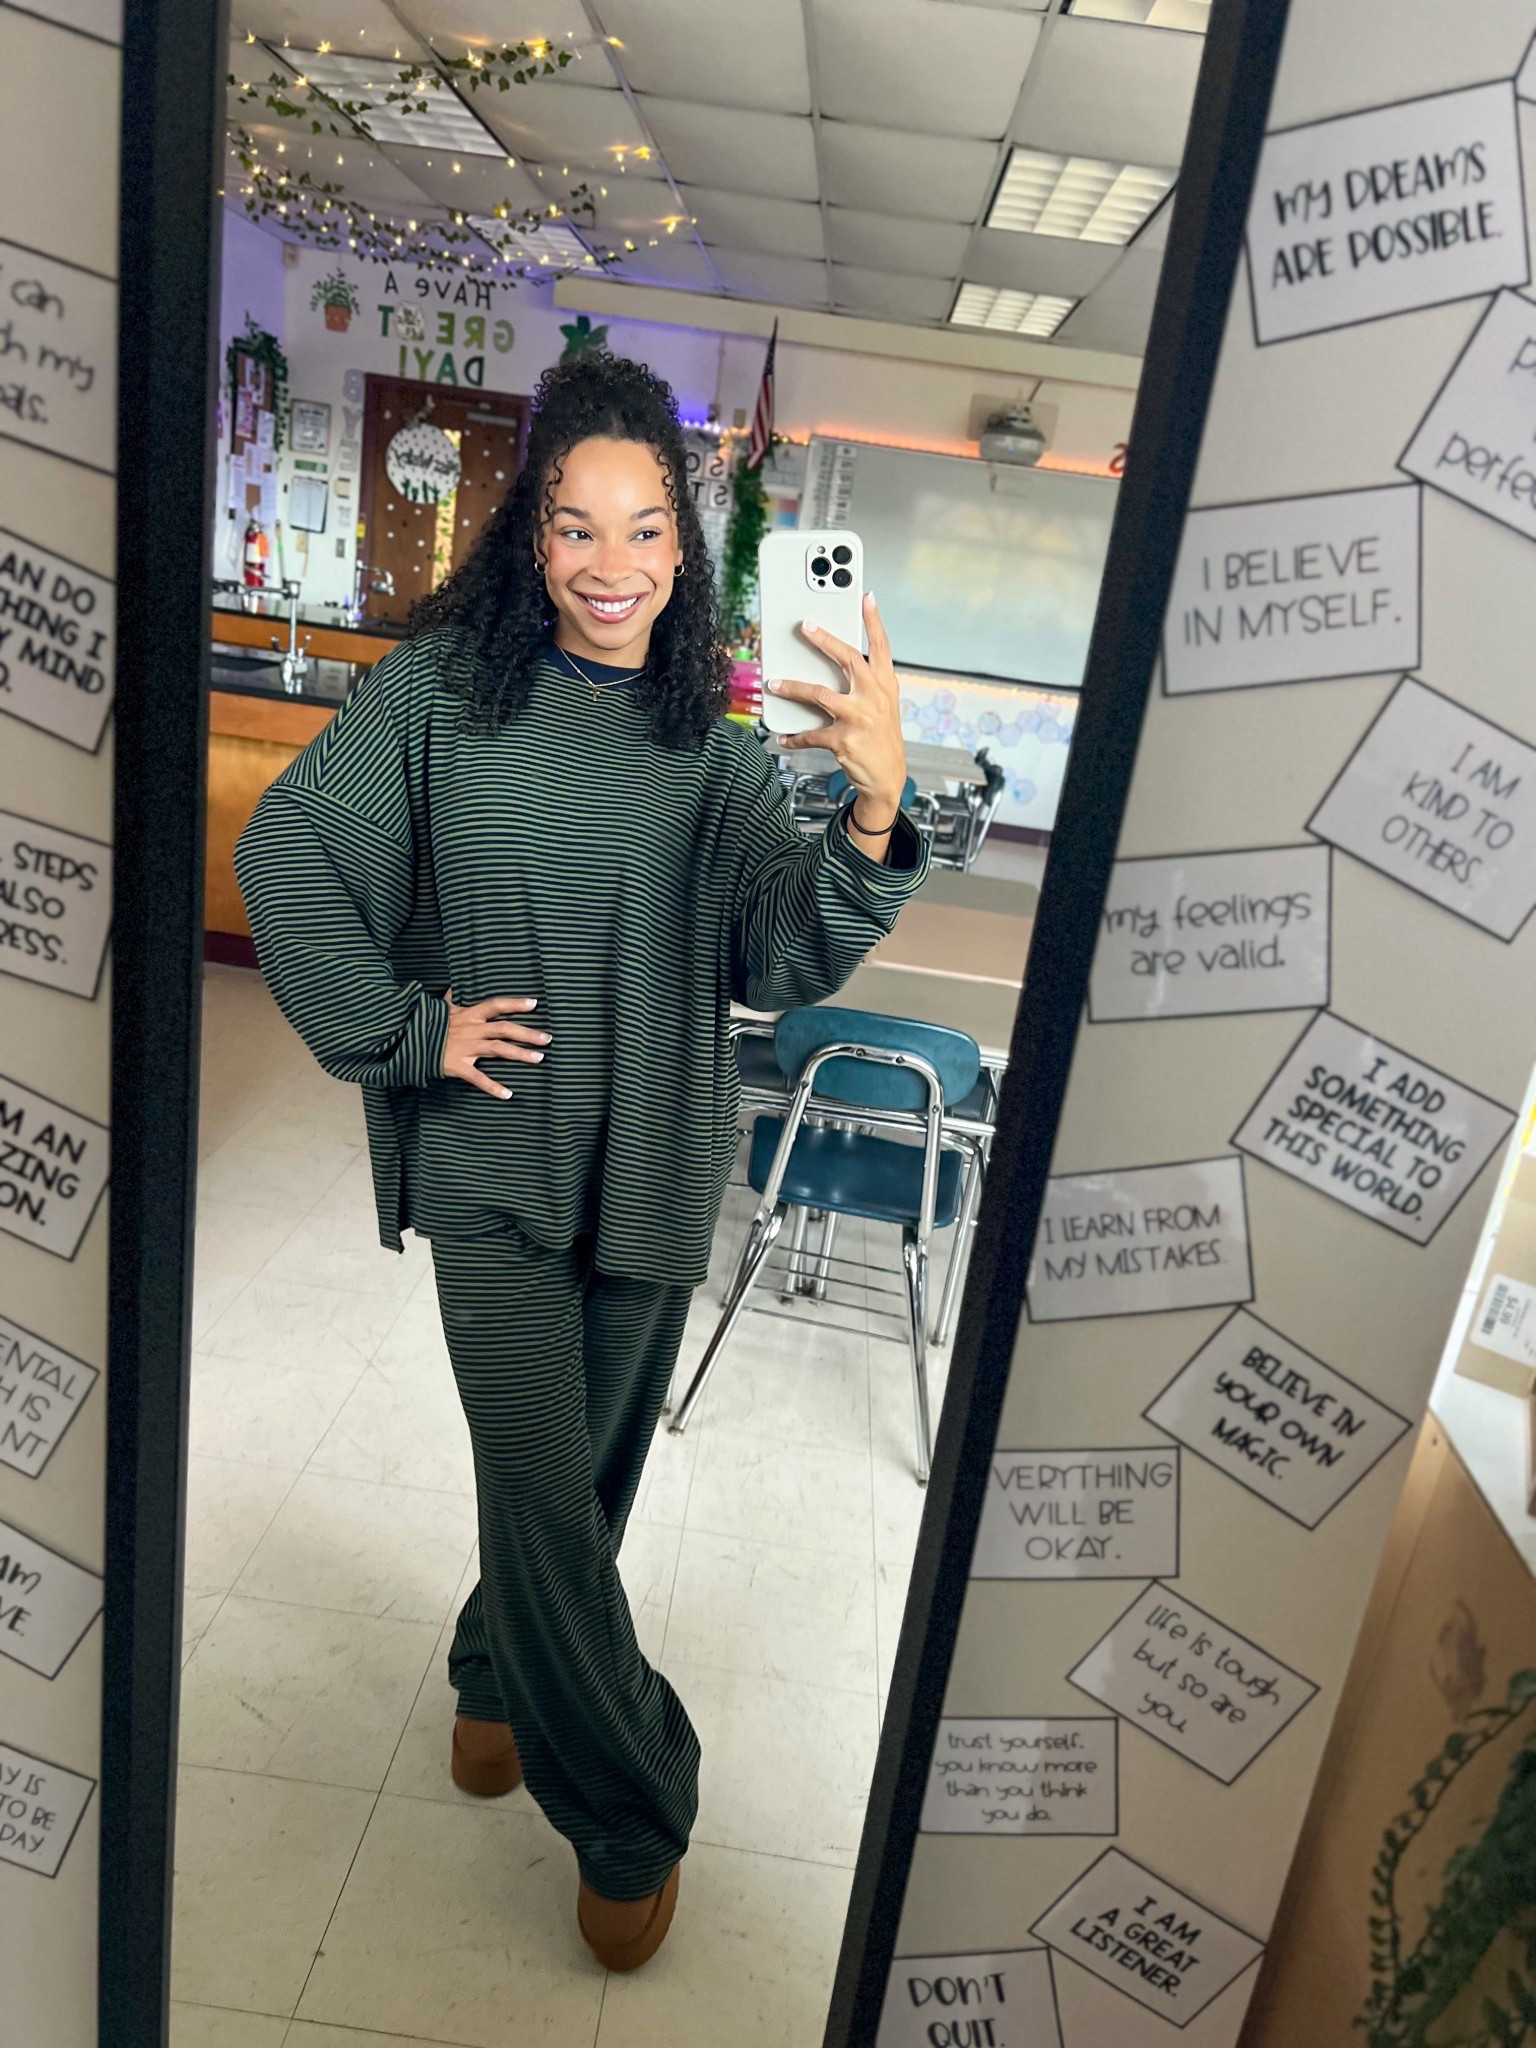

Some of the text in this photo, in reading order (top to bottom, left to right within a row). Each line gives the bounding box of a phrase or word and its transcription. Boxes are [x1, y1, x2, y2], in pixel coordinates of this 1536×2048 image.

[1274, 142, 1486, 226] MY DREAMS
[1271, 238, 1335, 290] ARE
[38, 344, 94, 392] my
[1435, 431, 1536, 510] perfe
[1203, 536, 1380, 592] I BELIEVE
[51, 575, 96, 616] DO
[1184, 588, 1402, 648] IN MYSELF.
[18, 636, 105, 695] MIND
[86, 631, 107, 661] I
[1451, 743, 1522, 800] I AM
[1402, 771, 1514, 850] KIND TO
[13, 841, 99, 892] STEPS
[1104, 892, 1312, 938] my feelings
[1130, 934, 1286, 977] are valid.
[1362, 1057, 1447, 1115] I ADD
[1304, 1065, 1467, 1164] SOMETHING
[32, 1123, 88, 1166] AN
[1287, 1094, 1443, 1190] SPECIAL TO
[1263, 1117, 1424, 1222] THIS WORLD.
[1044, 1203, 1222, 1245] I LEARN FROM
[1044, 1252, 1087, 1281] MY
[19, 1391, 51, 1423] IS
[1241, 1346, 1367, 1438] BELIEVE IN
[1213, 1371, 1346, 1468] YOUR OWN
[1210, 1416, 1291, 1481] MAGIC.
[992, 1461, 1174, 1491] VERYTHING
[1009, 1500, 1135, 1526] WILL BE
[1025, 1535, 1122, 1561] OKAY.
[1144, 1604, 1280, 1706] life is tough
[1132, 1638, 1247, 1724] but so are
[1137, 1692, 1188, 1734] you
[936, 1757, 1098, 1776] you know more
[947, 1732, 1085, 1752] trust yourself.
[24, 1774, 47, 1796] IS
[946, 1780, 1088, 1800] than you think
[31, 1806, 56, 1832] BE
[982, 1804, 1052, 1823] you do.
[1097, 1907, 1200, 1973] A GREAT
[1133, 1896, 1202, 1946] I AM
[1070, 1917, 1181, 1998] LISTENER.
[927, 2018, 1006, 2048] QUIT.
